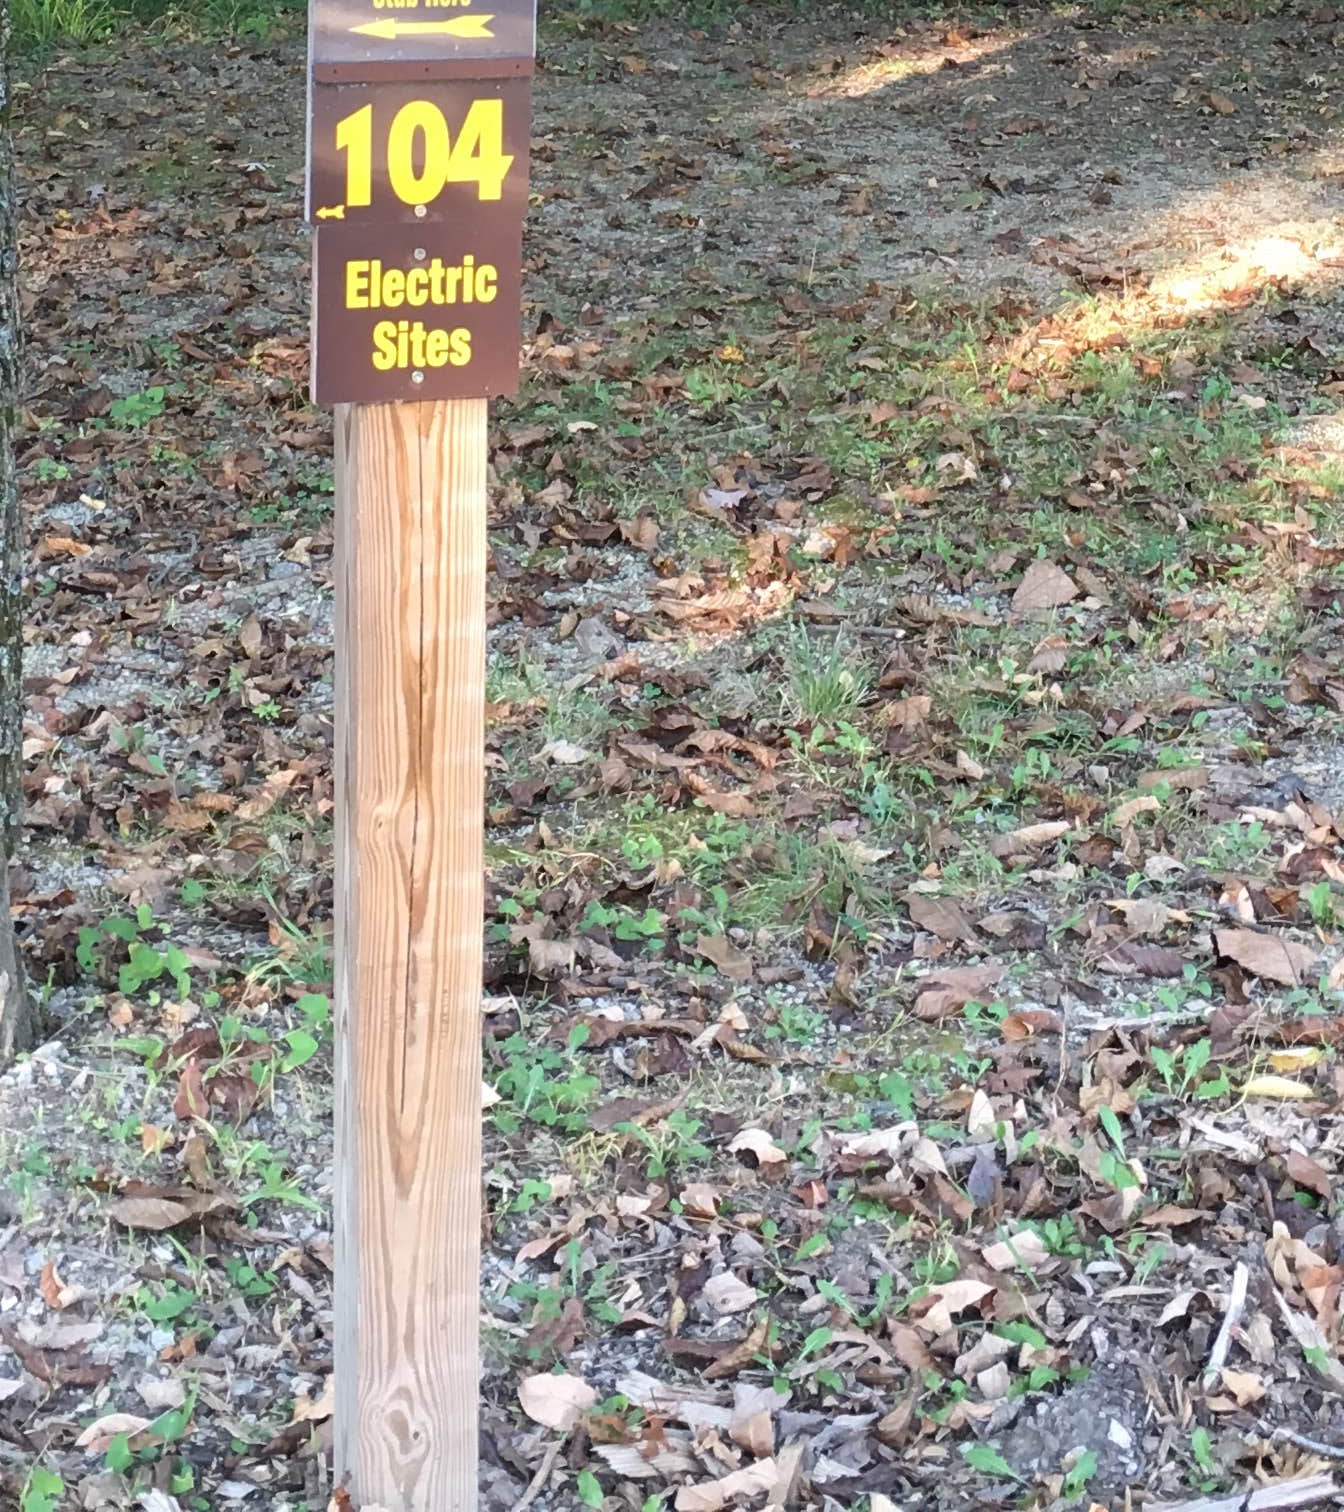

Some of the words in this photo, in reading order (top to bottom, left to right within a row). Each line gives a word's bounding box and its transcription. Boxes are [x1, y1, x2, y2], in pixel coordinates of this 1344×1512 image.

[336, 99, 514, 207] 104
[345, 254, 498, 309] Electric
[372, 320, 472, 370] Sites
